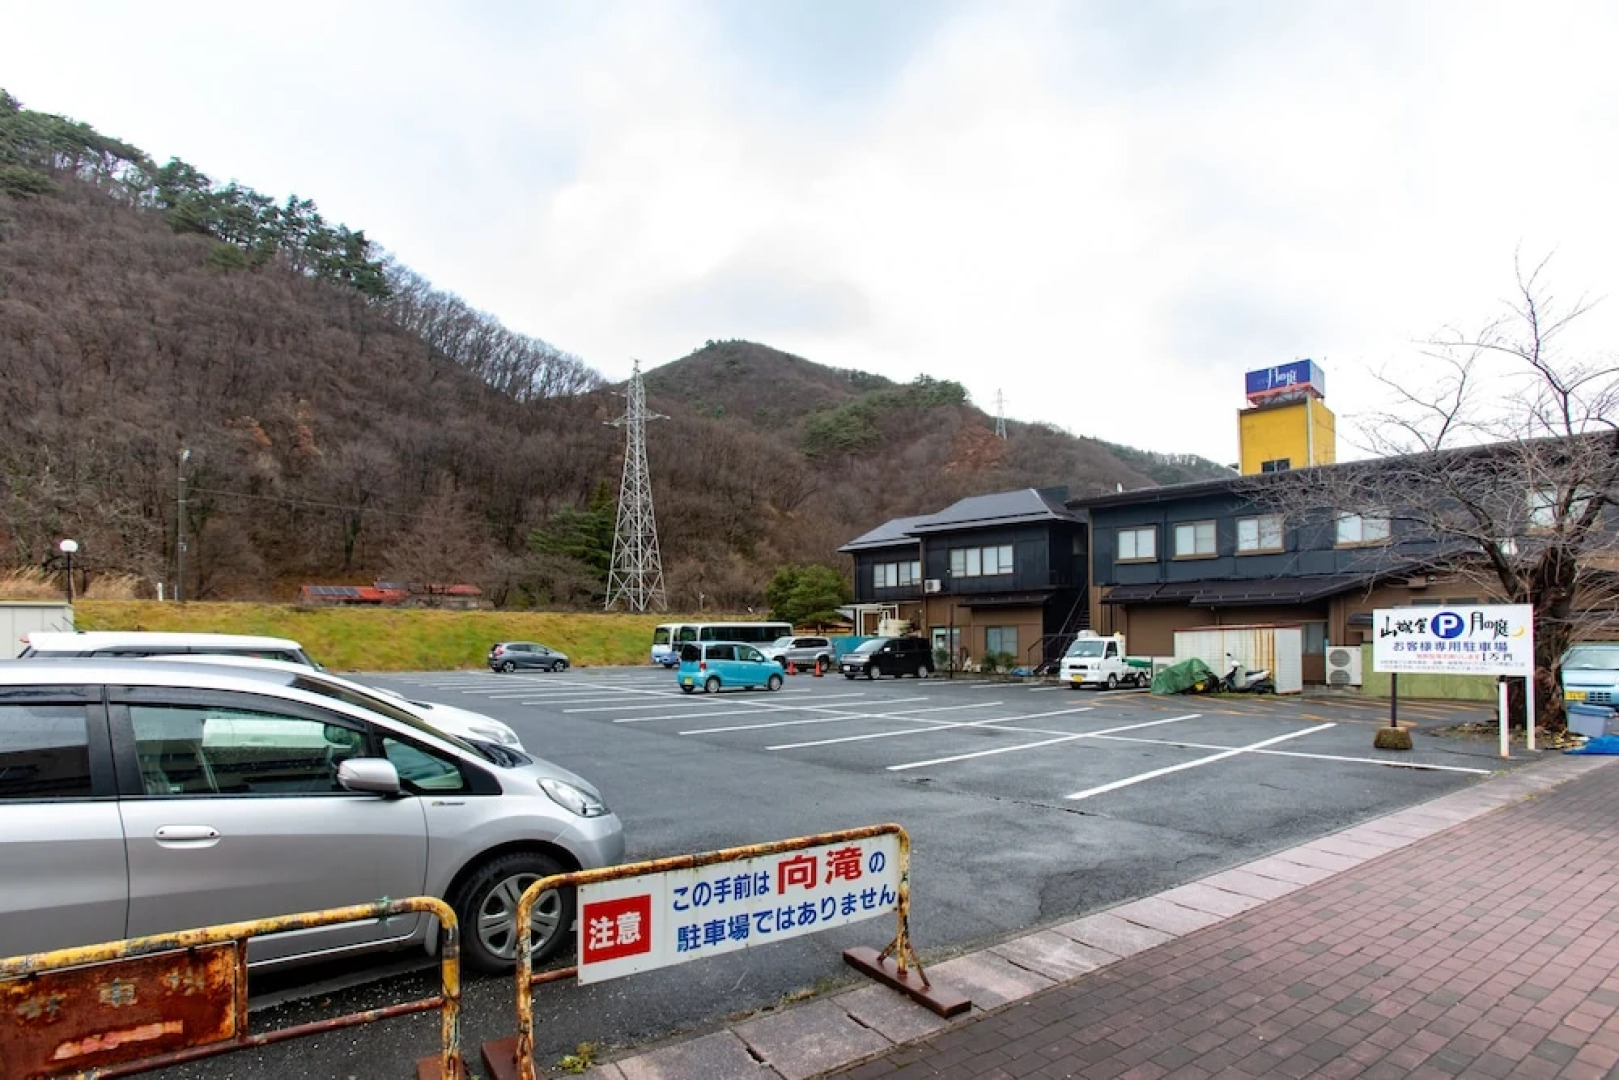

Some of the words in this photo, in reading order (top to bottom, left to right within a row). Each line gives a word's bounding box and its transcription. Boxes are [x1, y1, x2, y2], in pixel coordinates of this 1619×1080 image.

[1393, 640, 1508, 652] お客様専用駐車場
[588, 911, 642, 951] 注意
[676, 883, 897, 953] 駐車場ではありません
